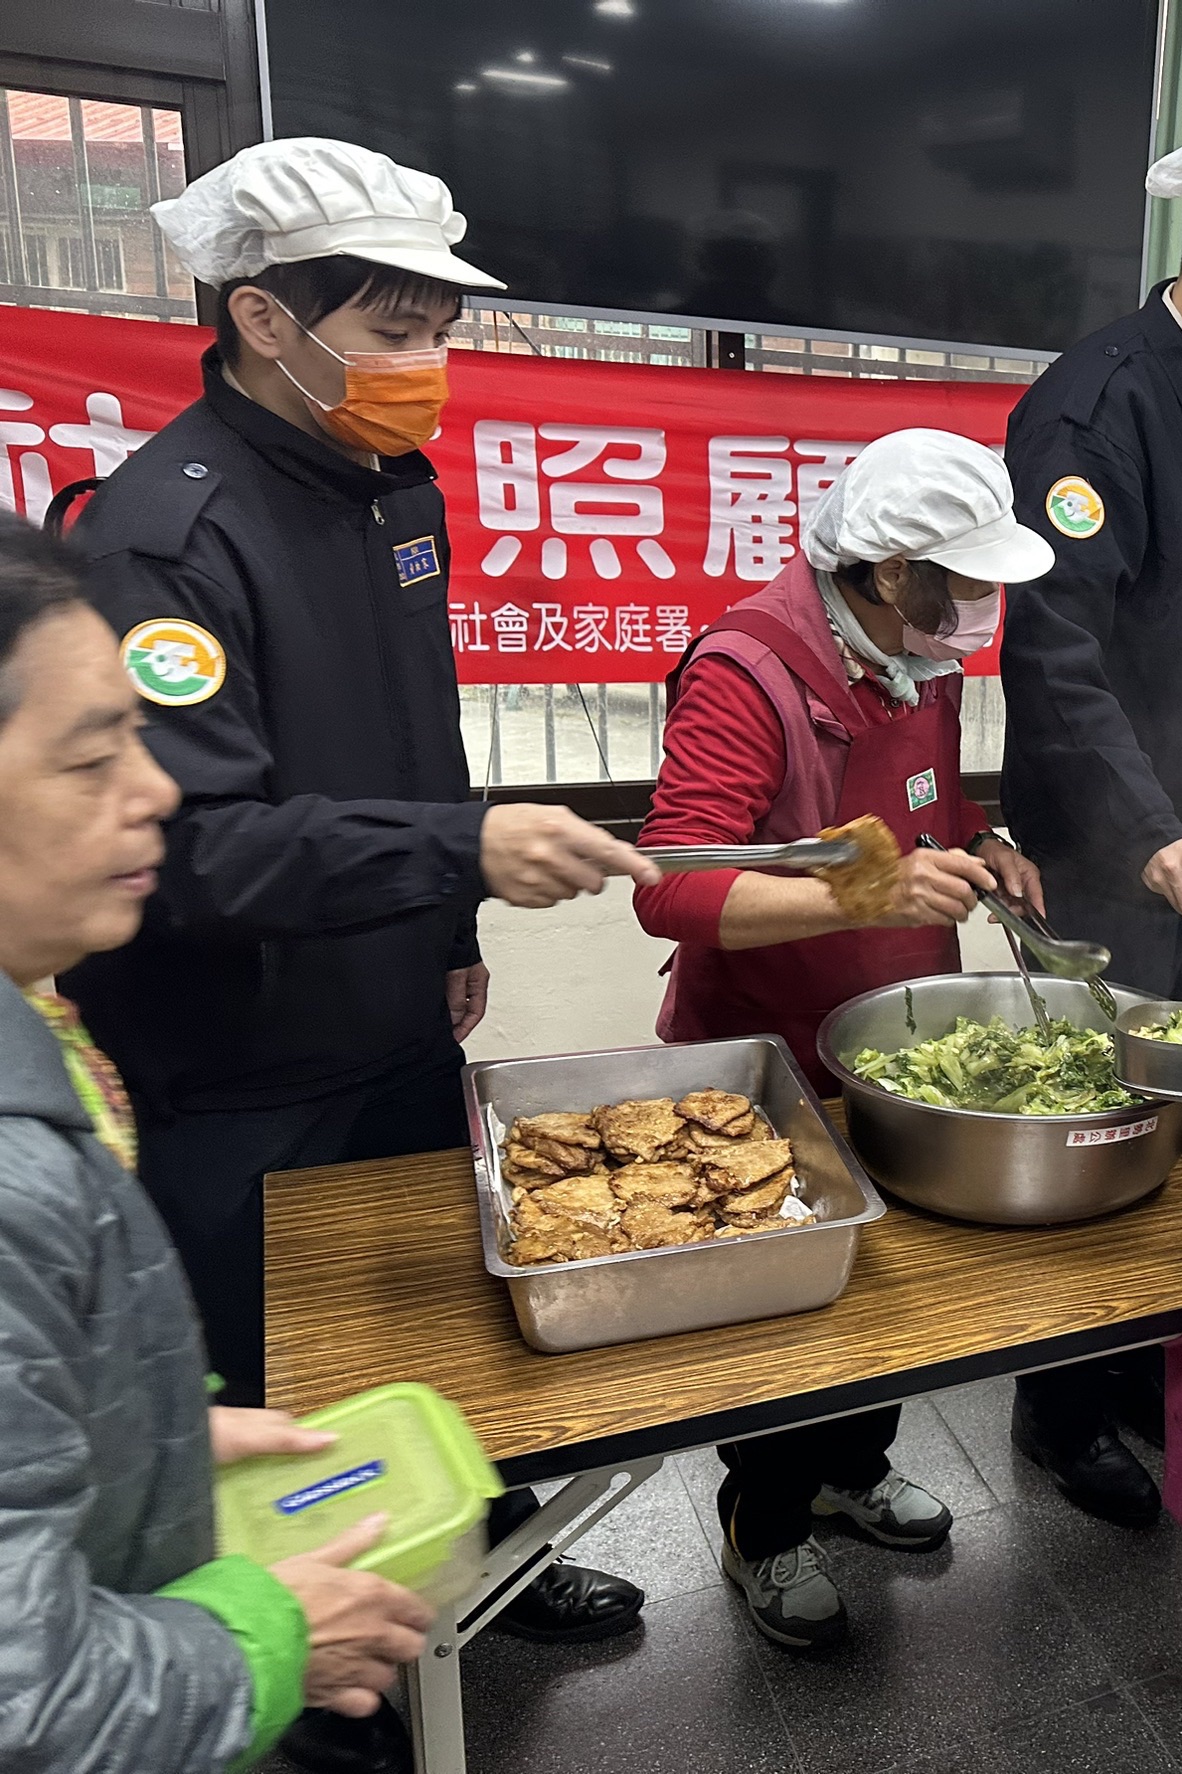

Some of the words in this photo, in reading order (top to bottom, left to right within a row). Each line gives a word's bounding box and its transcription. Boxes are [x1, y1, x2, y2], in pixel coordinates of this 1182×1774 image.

[449, 601, 690, 654] 社會及家庭署
